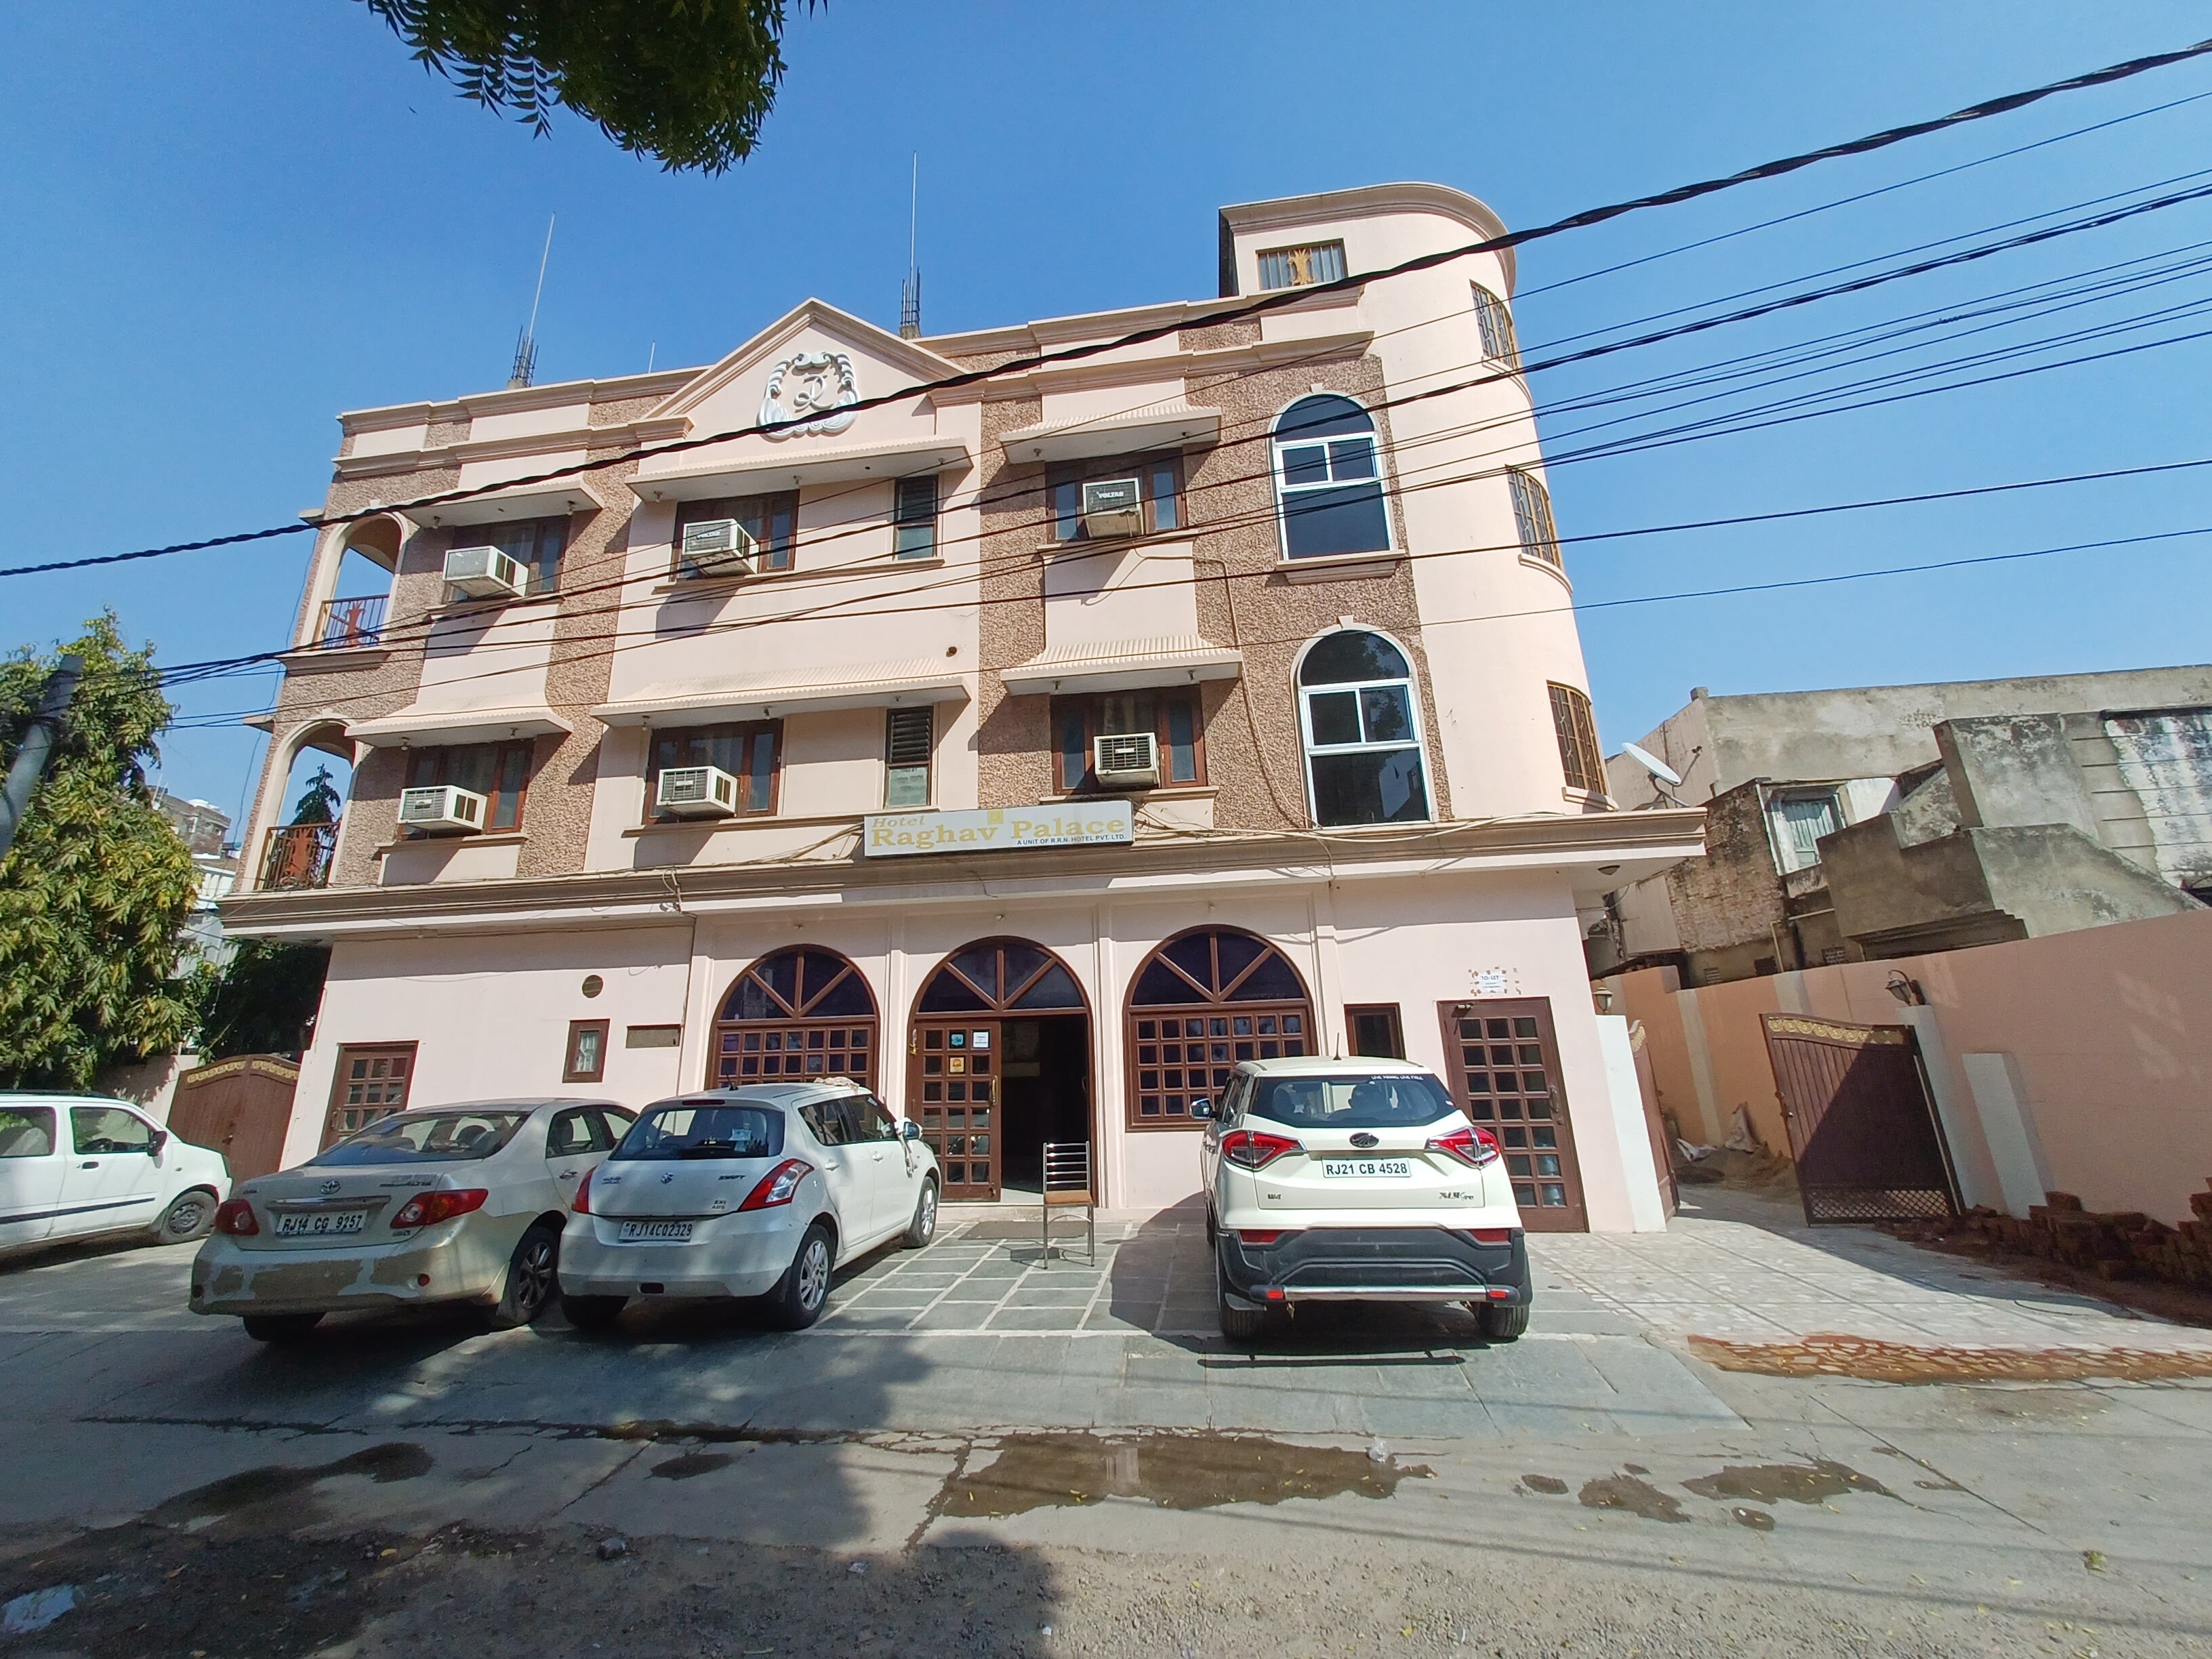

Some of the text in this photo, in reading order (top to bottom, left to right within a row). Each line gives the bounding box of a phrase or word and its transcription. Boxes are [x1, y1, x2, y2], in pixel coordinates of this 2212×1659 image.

[872, 815, 926, 827] Hotel
[872, 817, 1124, 849] Raghav Palace
[1326, 1163, 1408, 1174] RJ21 CB 4528
[283, 1217, 310, 1231] RJ14
[314, 1217, 329, 1230] CG
[336, 1214, 363, 1229] 9257
